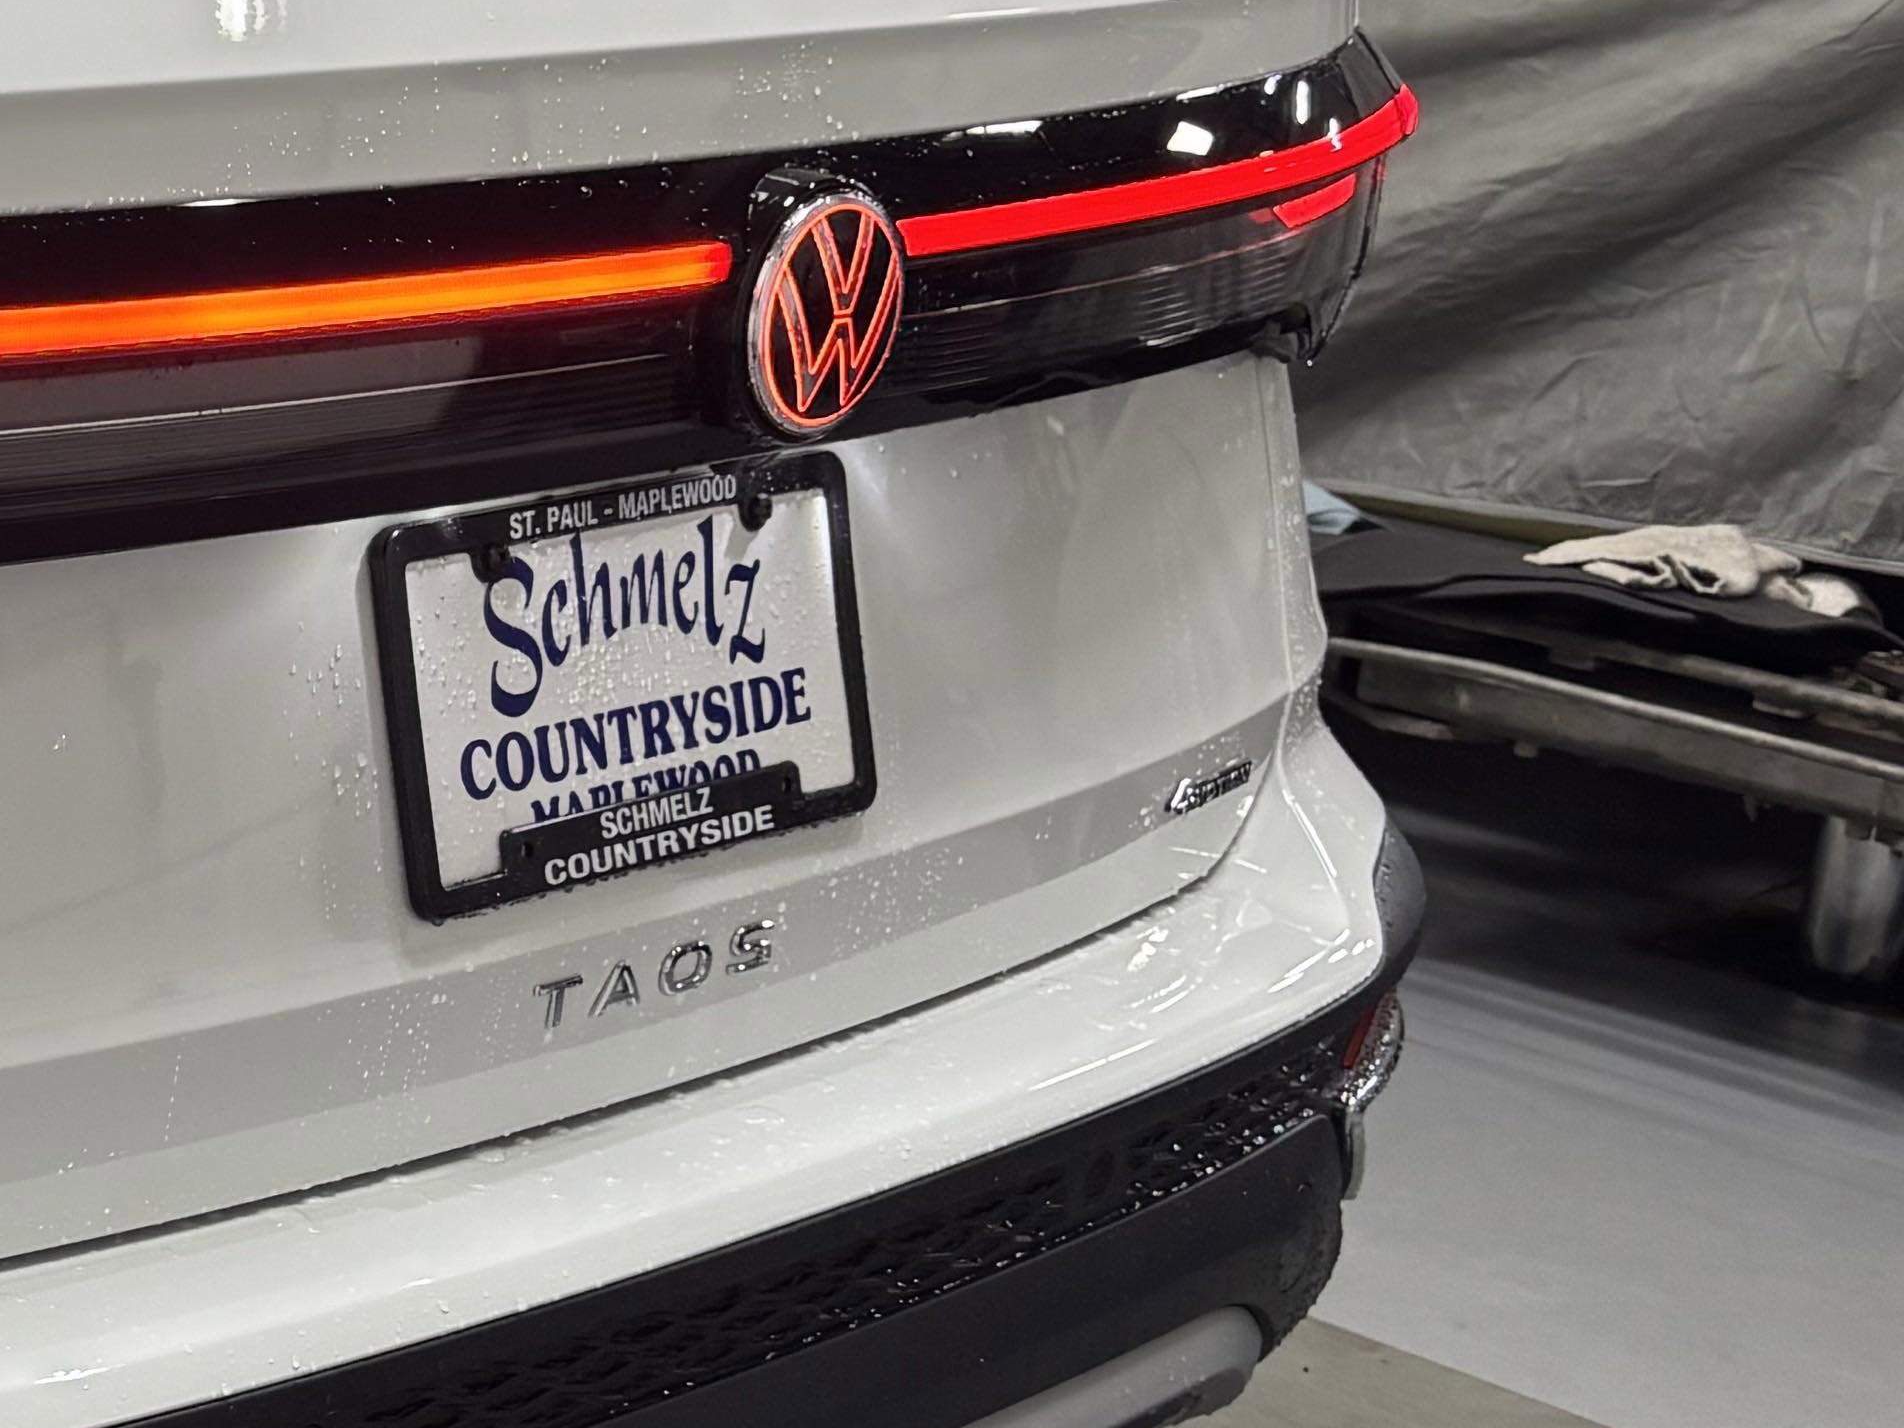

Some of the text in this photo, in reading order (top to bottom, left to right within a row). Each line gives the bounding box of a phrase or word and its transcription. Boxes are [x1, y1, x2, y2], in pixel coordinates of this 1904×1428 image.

[509, 510, 541, 539] ST.
[547, 500, 598, 533] PAUL
[618, 474, 737, 520] MAPLEWOOD
[483, 515, 766, 717] Schmelz
[460, 668, 811, 800] COUNTRYSIDE
[544, 804, 775, 885] COUNTRYSIDE
[599, 786, 714, 839] SCHMELZ
[533, 918, 776, 1030] TAOS
